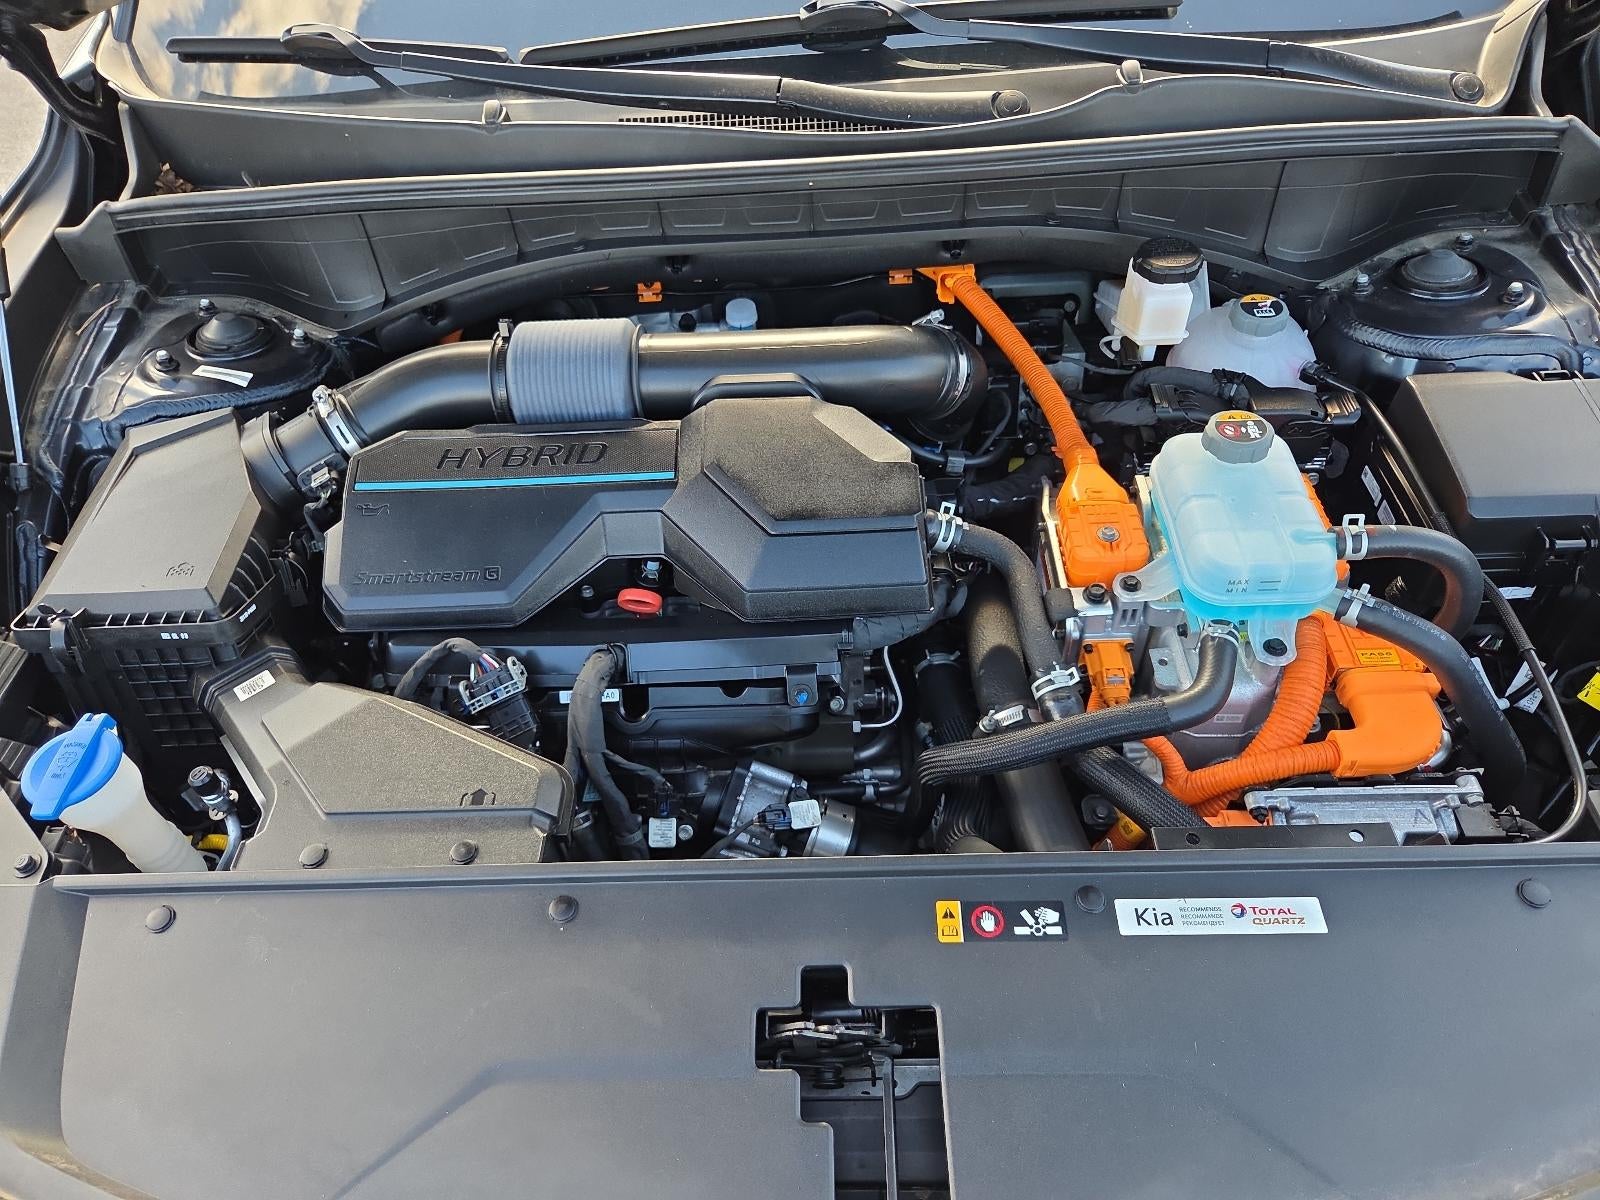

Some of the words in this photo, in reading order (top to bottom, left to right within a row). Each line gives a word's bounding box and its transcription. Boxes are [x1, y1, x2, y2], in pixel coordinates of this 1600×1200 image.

[436, 442, 609, 470] HYBRID
[353, 570, 481, 584] Smartstream
[1134, 907, 1174, 927] Kia
[1252, 917, 1306, 926] QUARTZ
